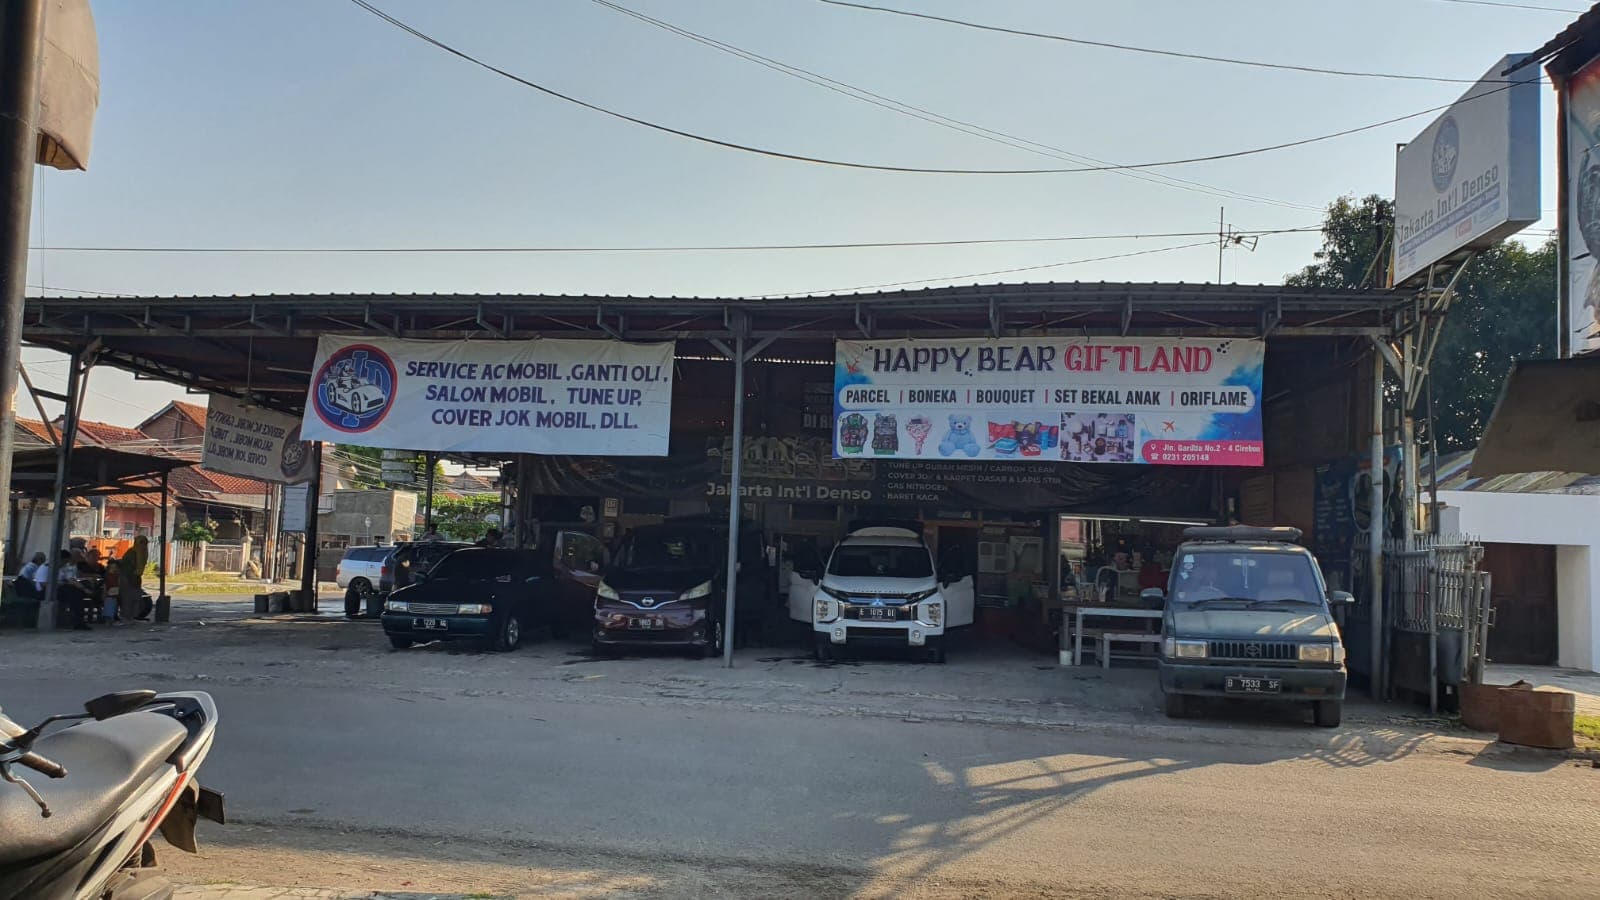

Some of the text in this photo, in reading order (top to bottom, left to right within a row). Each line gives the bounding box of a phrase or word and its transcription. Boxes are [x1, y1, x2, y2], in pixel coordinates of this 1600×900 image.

[1400, 209, 1433, 243] Jakarta
[1462, 164, 1498, 201] Denso
[873, 344, 1213, 372] HAPPY BEAR GIFTLAND
[405, 360, 478, 379] SERVICE
[481, 363, 505, 380] AC
[425, 384, 486, 402] SALON
[567, 387, 614, 405] TUNE
[846, 388, 1248, 406] PARCEL BONEKA BOUQUET SET BEKAL ANAK ORIFLAME
[431, 408, 492, 426] COVER
[495, 409, 530, 426] JOK
[1027, 466, 1056, 474] CLEAN
[707, 482, 872, 500] Jaarta Int'l Denso
[1240, 679, 1260, 688] 7533
